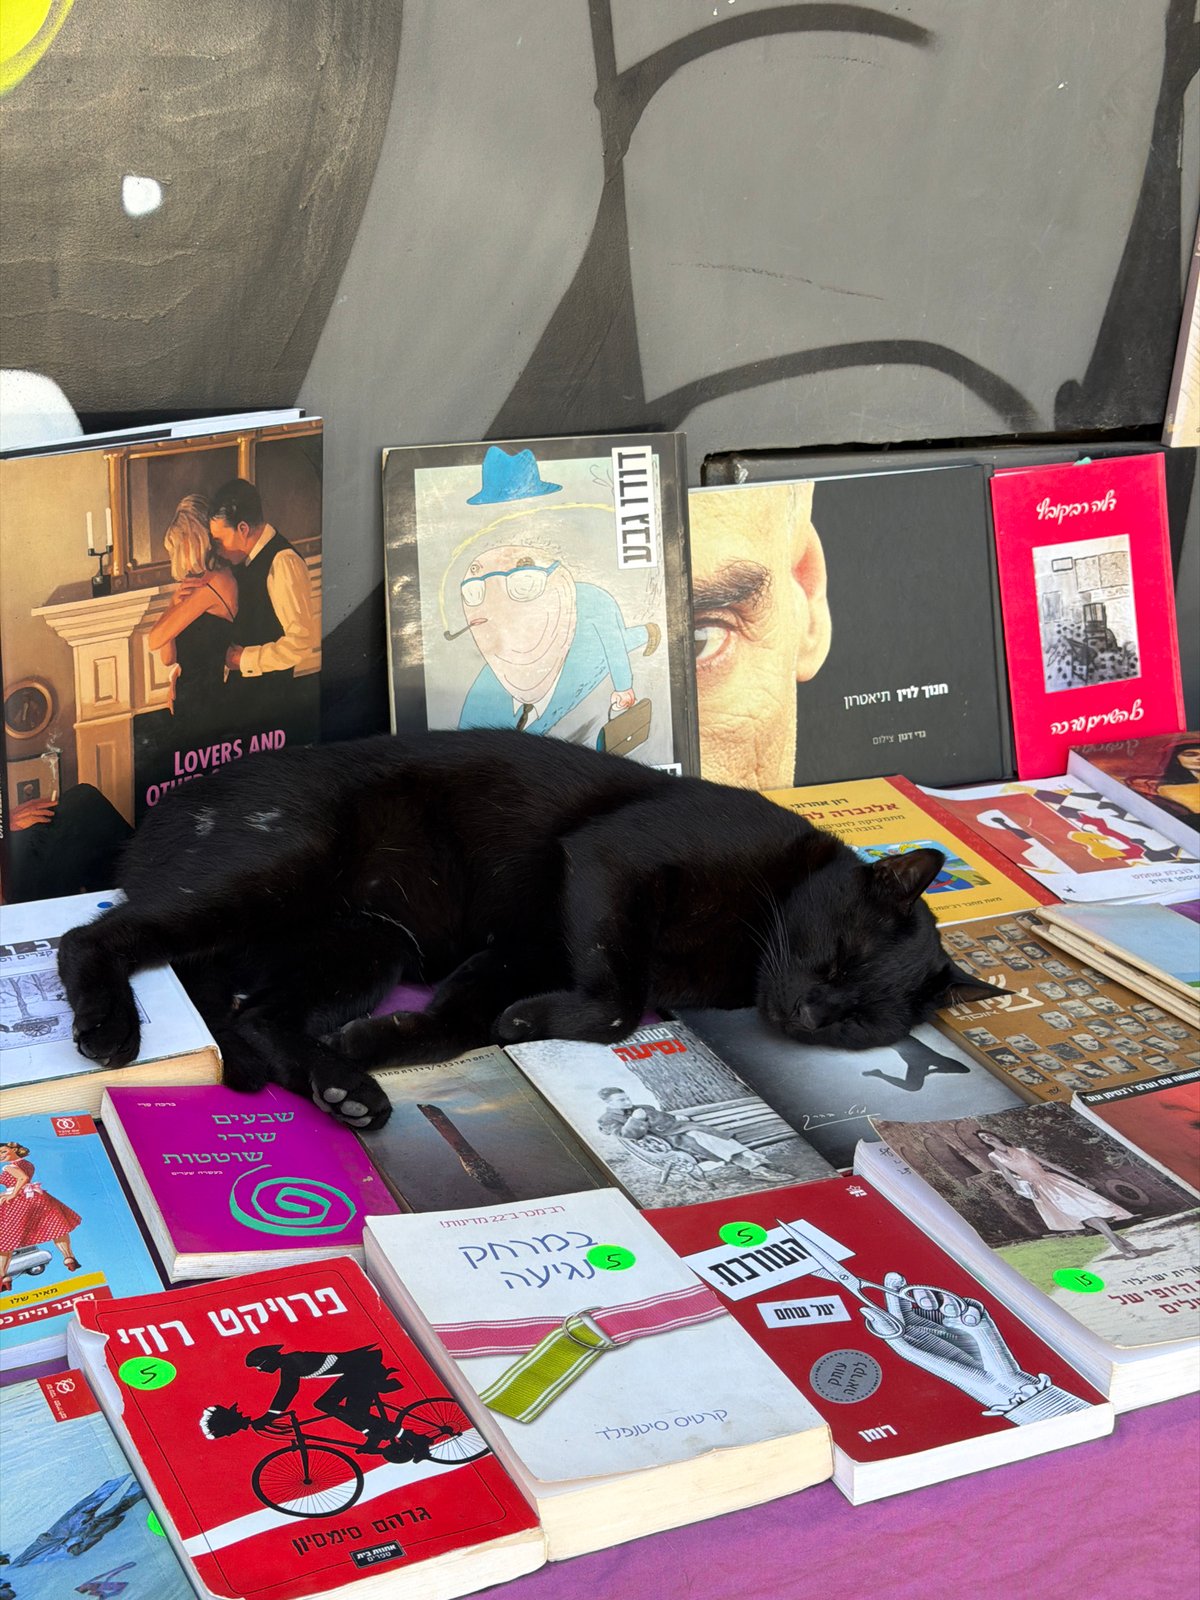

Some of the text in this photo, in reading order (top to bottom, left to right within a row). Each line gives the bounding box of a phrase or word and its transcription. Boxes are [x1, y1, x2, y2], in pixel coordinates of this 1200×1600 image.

[617, 452, 648, 507] דודו
[1036, 489, 1118, 525] דליה רביקוביץ
[621, 513, 653, 564] גבע
[843, 683, 949, 710] חנוך לוין תיאטרון
[1050, 722, 1070, 735] כה
[1070, 716, 1086, 732] עד
[1086, 708, 1129, 733] השירים
[872, 735, 895, 745] צילום
[174, 729, 286, 776] LOVERS AND
[790, 800, 828, 808] אהרוני
[829, 803, 900, 818] אלגברה
[859, 815, 906, 826] מתמטיקה
[613, 1039, 688, 1062] נסיעה
[211, 1111, 295, 1125] שבעים
[217, 1132, 277, 1143] שירי
[162, 1151, 264, 1165] שוטטות
[458, 1231, 598, 1270] במרחק
[707, 1237, 813, 1288] העורכת
[500, 1258, 596, 1290] נגיעה
[9, 1287, 59, 1306] מאיר שלו
[1107, 1292, 1145, 1306] של
[1143, 1282, 1198, 1299] היופי
[18, 1306, 50, 1321] היה
[116, 1286, 349, 1356] פרויקט רוזי
[773, 1303, 836, 1321] יעל שחם
[827, 1361, 848, 1387] עותק
[842, 1361, 868, 1396] לקריאה
[594, 1409, 729, 1441] קרטיס סיטנפלד
[857, 1424, 899, 1443] רומן
[292, 1506, 432, 1556] גרהם סימסיון
[366, 1552, 392, 1562] ספרים
